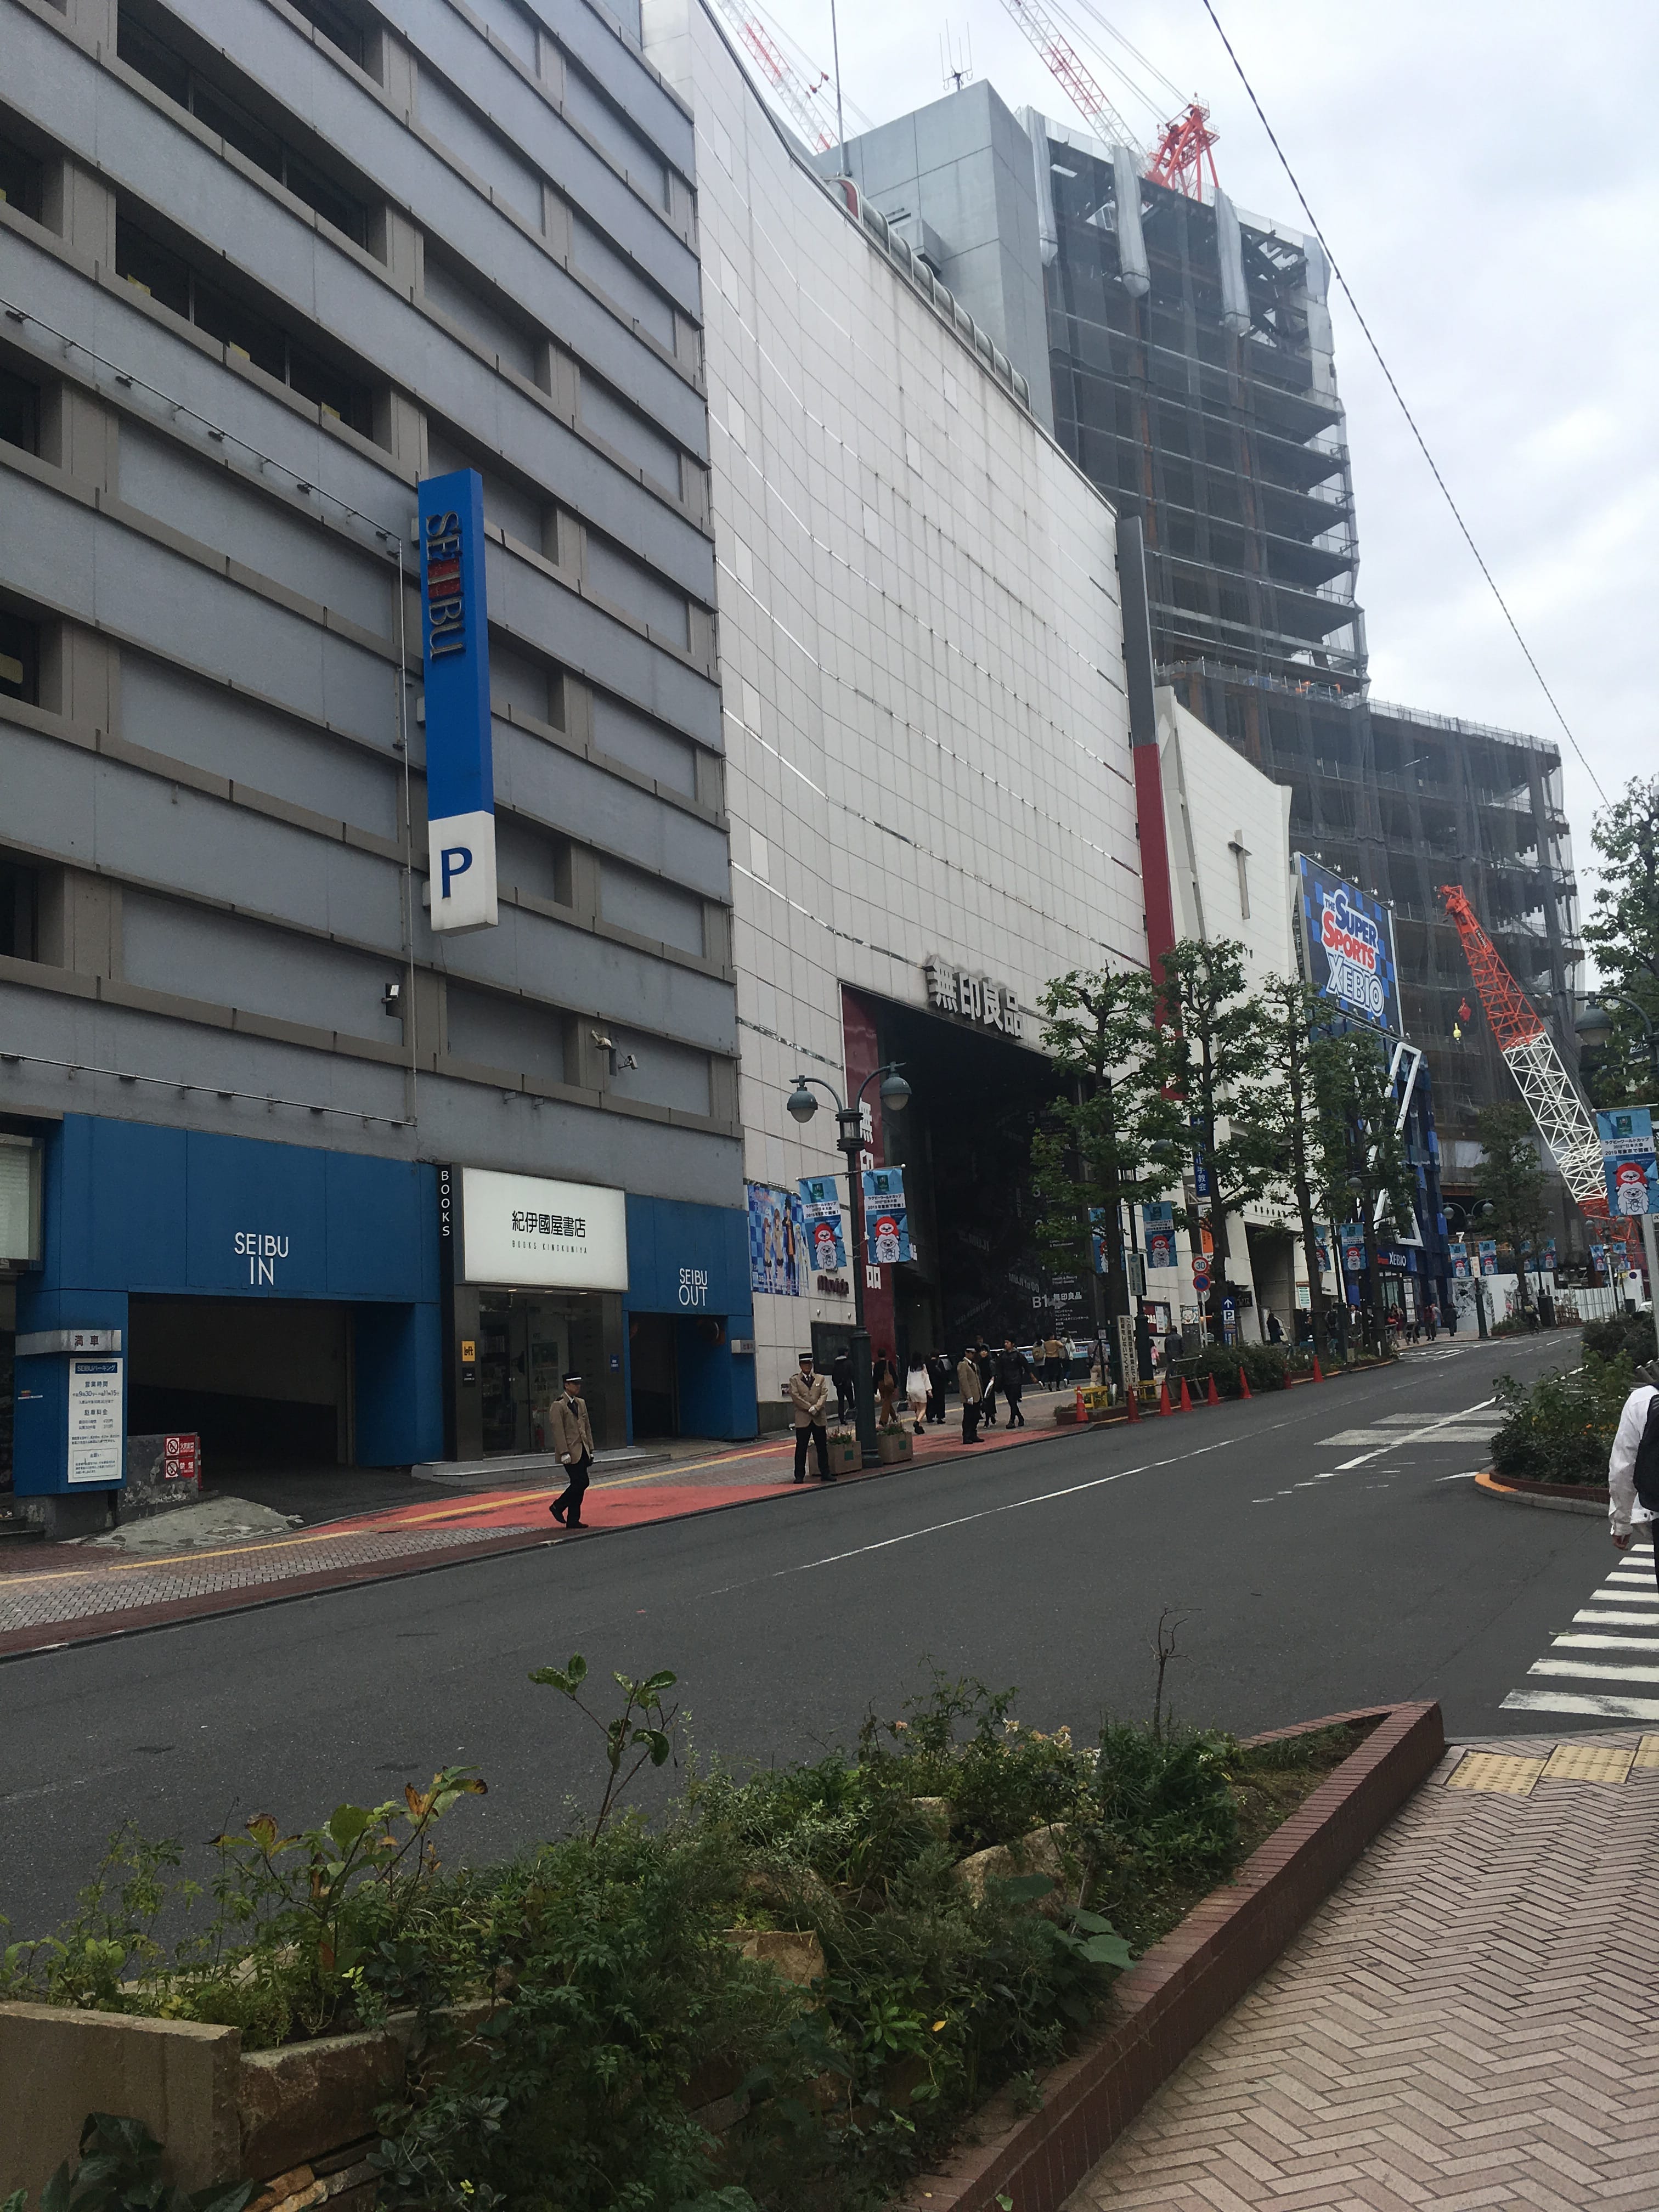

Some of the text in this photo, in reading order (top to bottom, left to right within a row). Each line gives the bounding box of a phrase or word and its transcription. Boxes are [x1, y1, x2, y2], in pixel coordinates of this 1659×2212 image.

[426, 511, 463, 660] SEIBU
[441, 847, 473, 898] P
[1325, 898, 1335, 912] THE
[1335, 894, 1376, 949] SUPER
[1323, 911, 1375, 970] SPORTS
[927, 955, 1024, 1039] 無印良品
[1327, 952, 1384, 1016] XEBIO
[441, 1171, 450, 1236] BOOKS
[512, 1210, 585, 1238] 紀伊國屋書店
[234, 1232, 288, 1257] SEIBU
[512, 1240, 587, 1254] BOOKS KINOKUNIYA
[251, 1256, 274, 1285] IN
[1195, 1261, 1206, 1269] 30
[1389, 1251, 1407, 1267] XEBIO
[680, 1268, 708, 1285] SEIBU
[679, 1285, 708, 1306] OUT
[1032, 1294, 1048, 1308] B1
[75, 1335, 99, 1346] 満車
